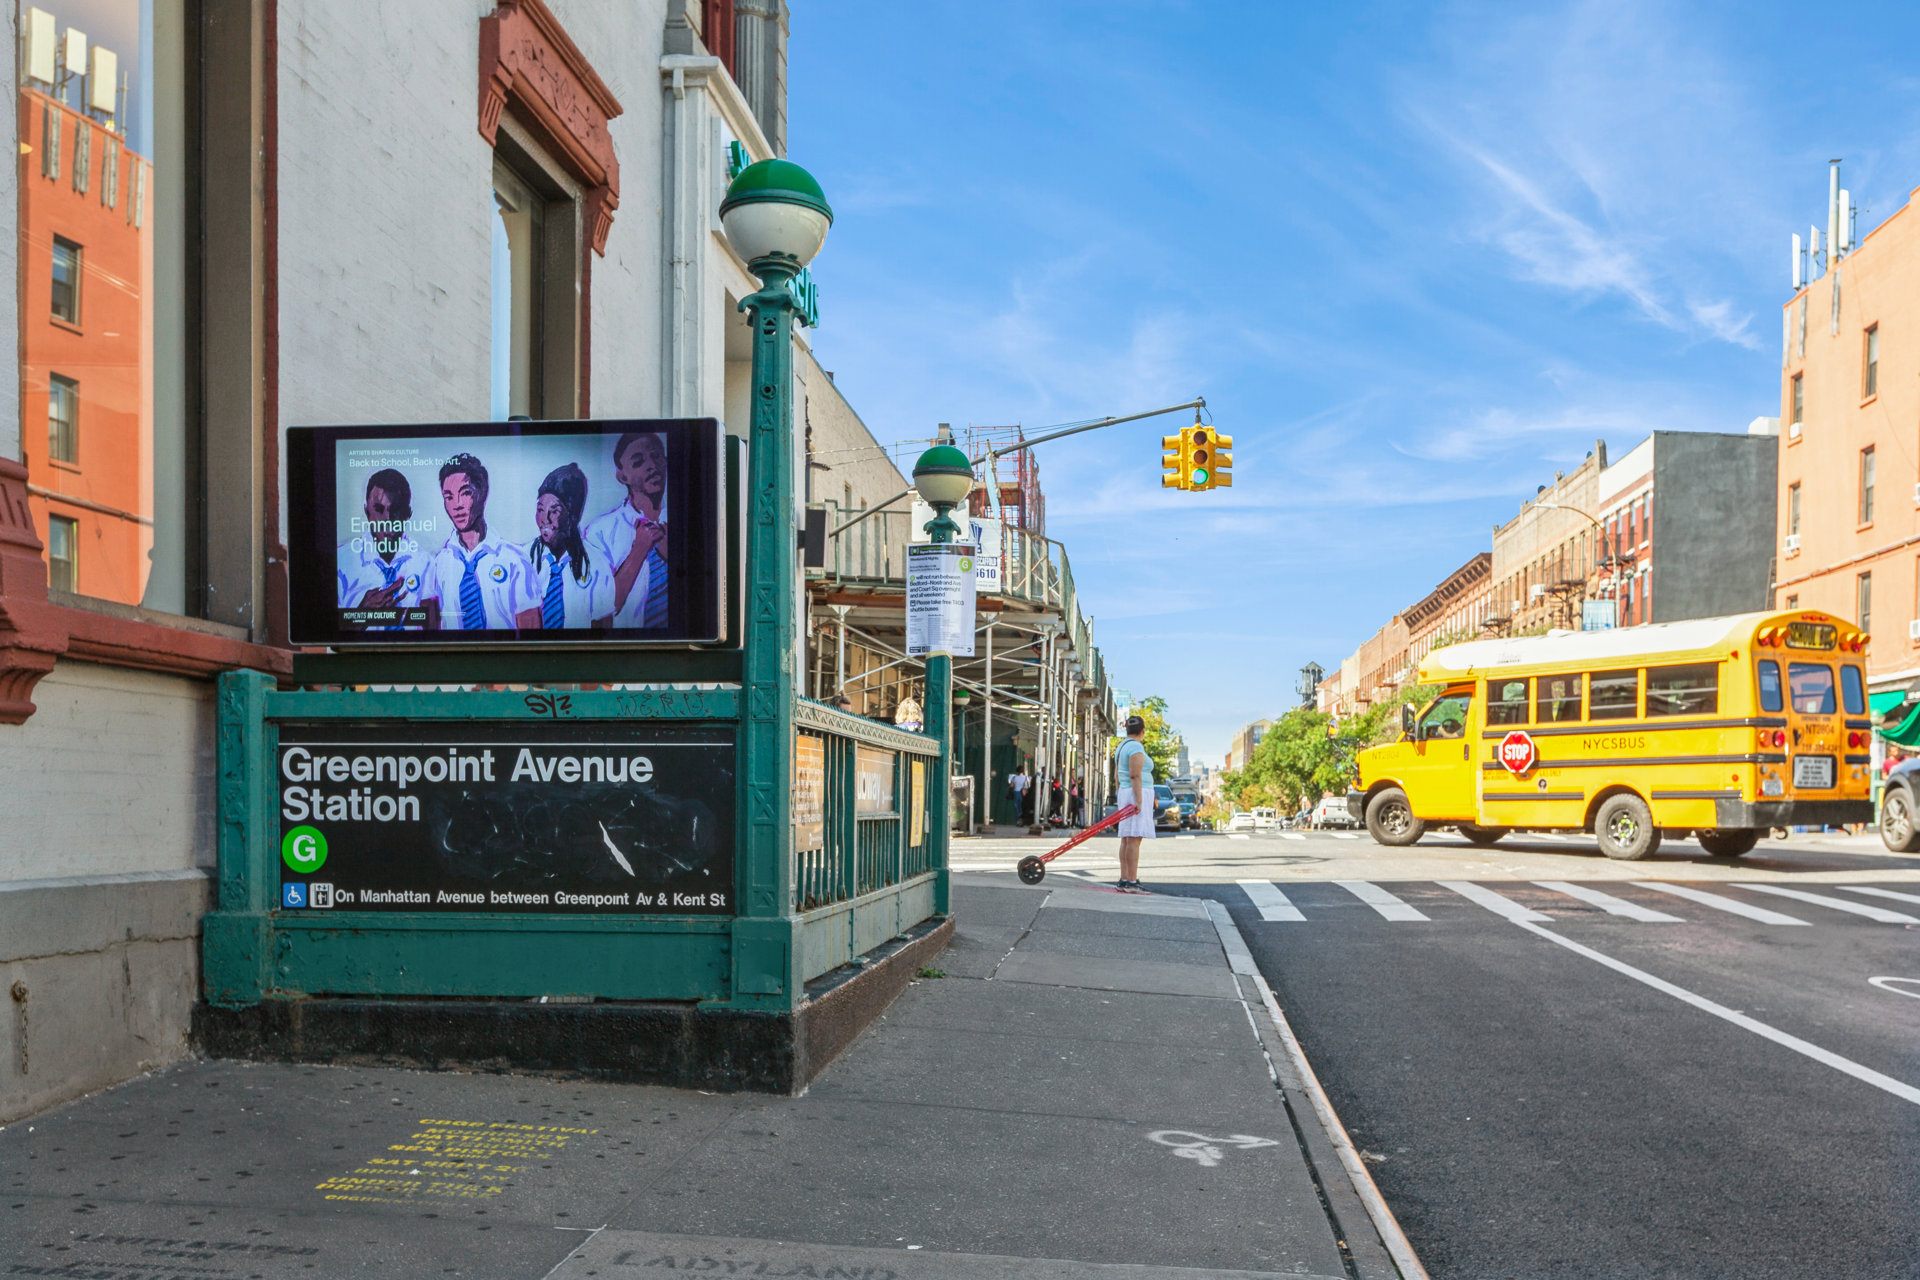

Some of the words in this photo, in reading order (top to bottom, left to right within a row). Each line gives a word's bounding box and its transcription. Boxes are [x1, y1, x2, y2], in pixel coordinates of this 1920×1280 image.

[349, 459, 370, 467] Back
[371, 459, 380, 467] to
[380, 458, 412, 467] School,
[413, 457, 434, 466] Back
[435, 457, 444, 465] to
[445, 457, 461, 466] Art.
[351, 516, 437, 533] Emmanuel
[350, 536, 418, 553] Chidube
[961, 560, 969, 569] G
[343, 612, 367, 620] MOMENTS
[367, 611, 373, 619] IN
[373, 611, 397, 619] CULTURE
[1583, 737, 1646, 750] NYCSBUS
[1505, 744, 1530, 761] STOP
[282, 747, 496, 789] Greenpoint
[511, 748, 654, 783] Avenue
[857, 762, 881, 808] ubway
[282, 787, 421, 822] Station
[292, 835, 317, 862] G
[335, 890, 355, 904] On
[360, 889, 430, 904] Manhattan
[437, 890, 485, 904] Avenue
[490, 890, 549, 905] between
[555, 891, 630, 908] Greenpoint
[636, 892, 653, 906] Av
[658, 892, 668, 906] &
[674, 893, 706, 906] Kent
[710, 893, 726, 907] St
[490, 1122, 598, 1134] FESTIVAL
